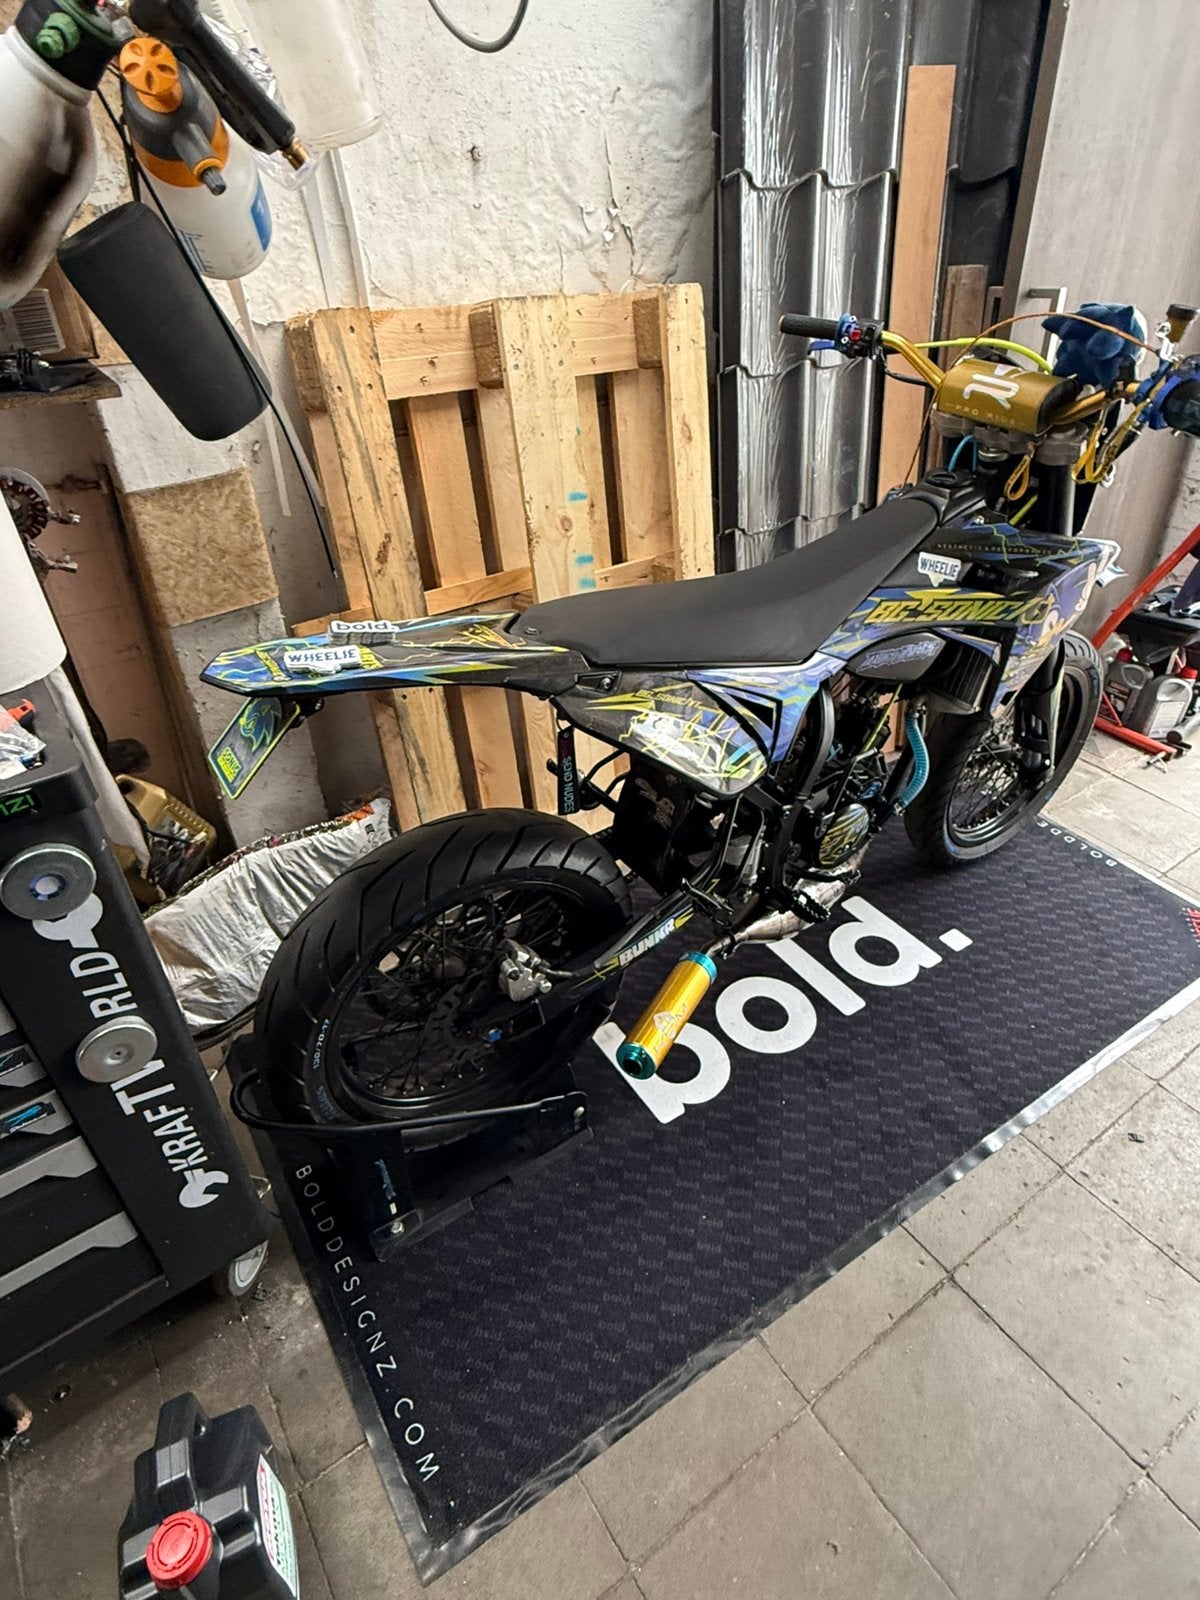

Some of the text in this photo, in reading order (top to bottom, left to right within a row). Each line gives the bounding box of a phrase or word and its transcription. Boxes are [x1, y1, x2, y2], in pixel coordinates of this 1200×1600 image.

[919, 556, 959, 577] WHEELIE
[288, 648, 359, 664] WHEELIE
[222, 748, 242, 775] SONIC
[563, 755, 576, 813] SEND NUDES
[592, 896, 973, 1125] bold.
[295, 1164, 440, 1482] BOLDDESIGNZ.COM
